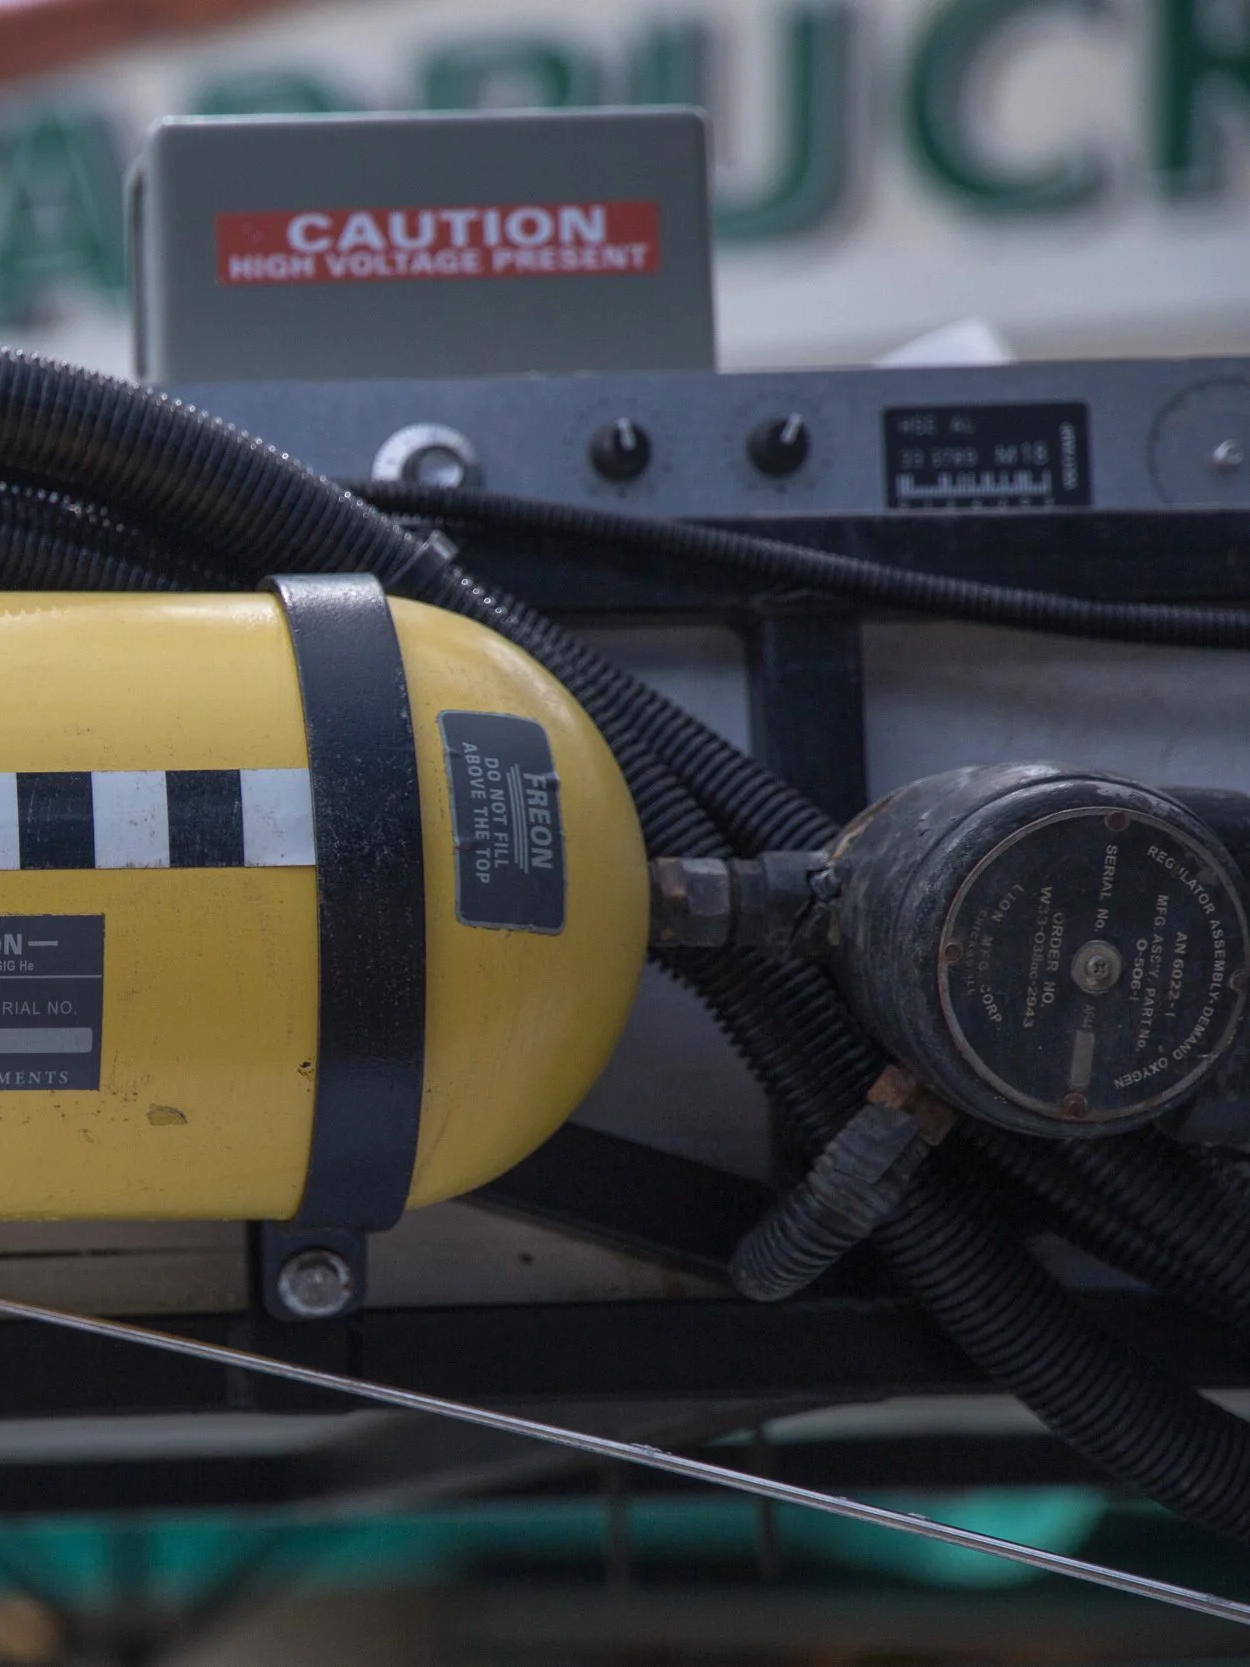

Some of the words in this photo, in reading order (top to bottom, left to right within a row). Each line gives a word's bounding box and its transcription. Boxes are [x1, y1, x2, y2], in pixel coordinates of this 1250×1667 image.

[287, 204, 606, 253] CAUTION
[229, 253, 315, 280] HIGH
[326, 248, 481, 277] VOLTAGE
[491, 242, 649, 273] PRESENT
[462, 741, 488, 799] ABOVE
[484, 757, 500, 782] DO
[473, 806, 490, 841] THE
[489, 788, 508, 826] NOT
[523, 772, 553, 869] FREON
[475, 847, 491, 884] TOP
[493, 832, 509, 869] FILL
[1098, 844, 1119, 902] SERIAL
[991, 884, 1025, 922] LION
[1094, 908, 1110, 932] No.
[1047, 911, 1066, 972] ORDER
[1174, 931, 1189, 955] AN
[19, 960, 35, 972] He
[47, 1000, 78, 1015] NO.
[1040, 981, 1056, 1008] NO.
[1140, 987, 1156, 1028] PART
[1135, 1029, 1151, 1052] No.
[1113, 1056, 1169, 1089] OXYGEN
